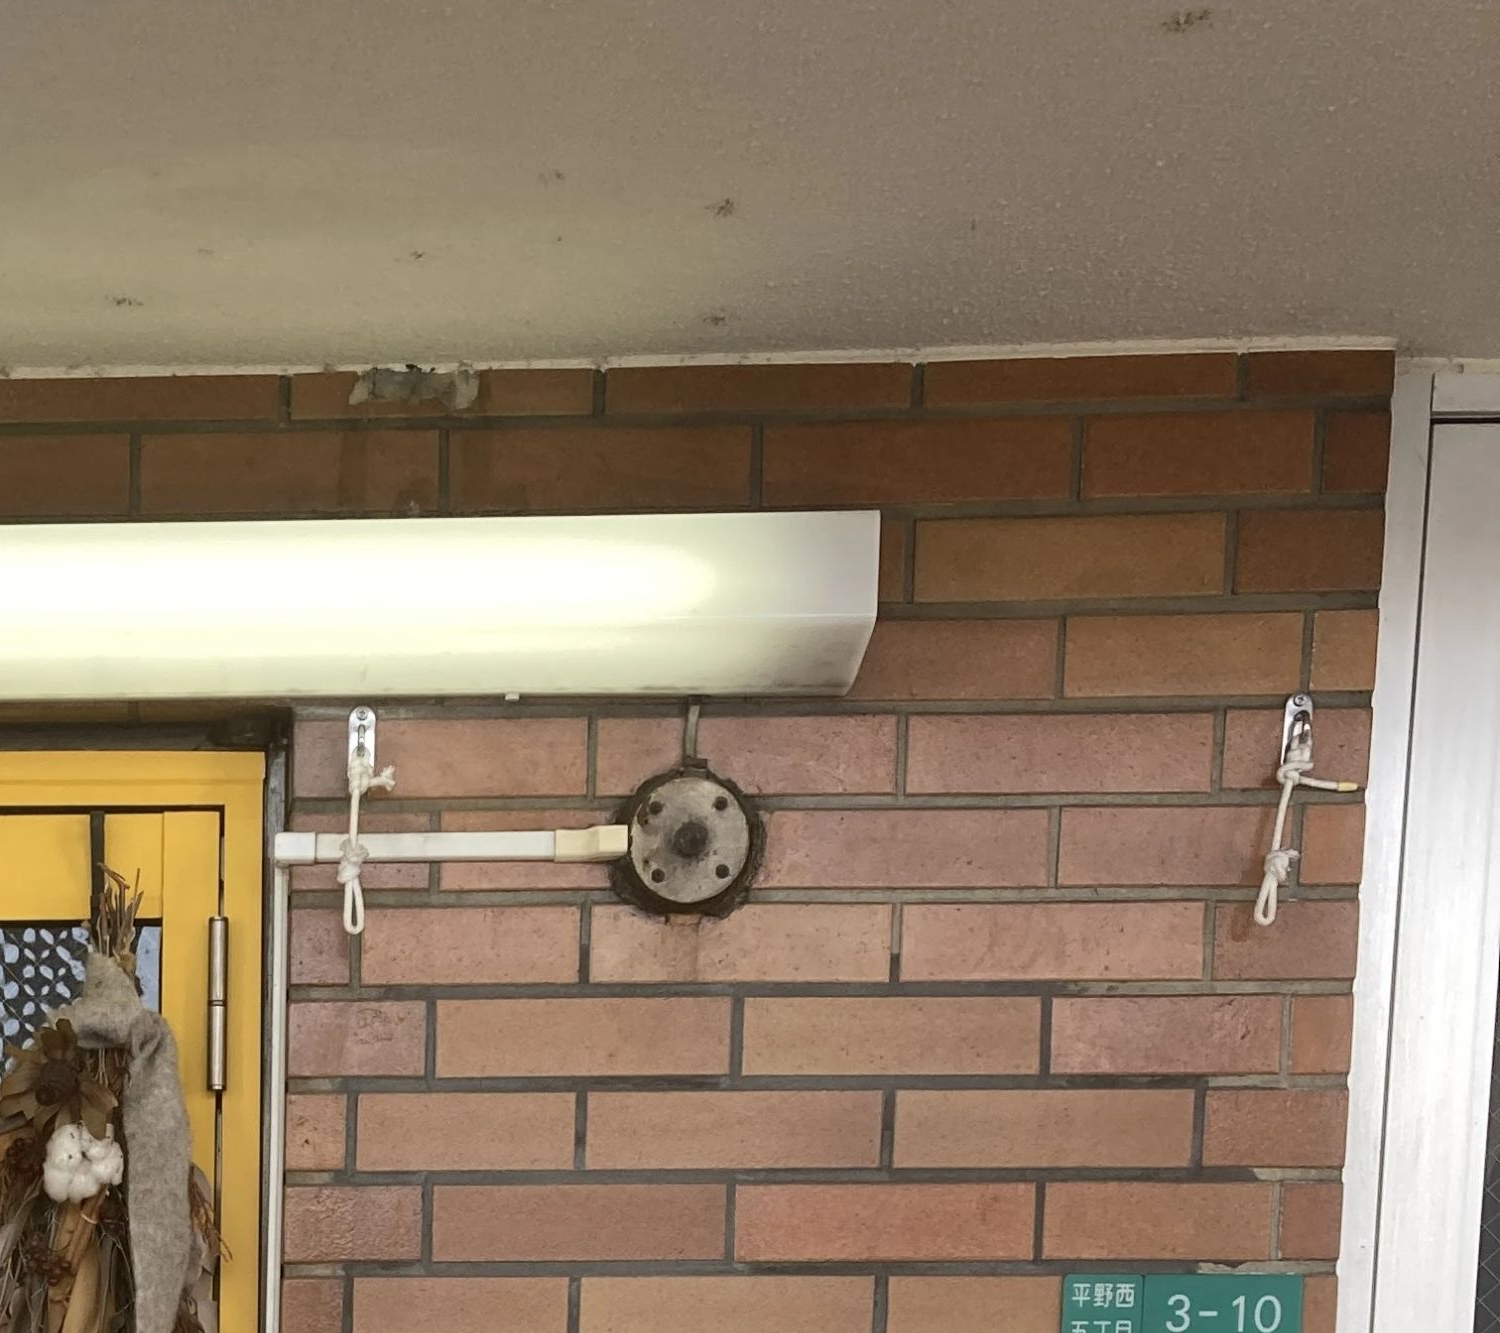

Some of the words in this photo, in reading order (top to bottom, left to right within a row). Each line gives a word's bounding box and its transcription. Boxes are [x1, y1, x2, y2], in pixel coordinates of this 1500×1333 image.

[1072, 1283, 1135, 1308] 平野西
[1165, 1294, 1282, 1333] 3-10
